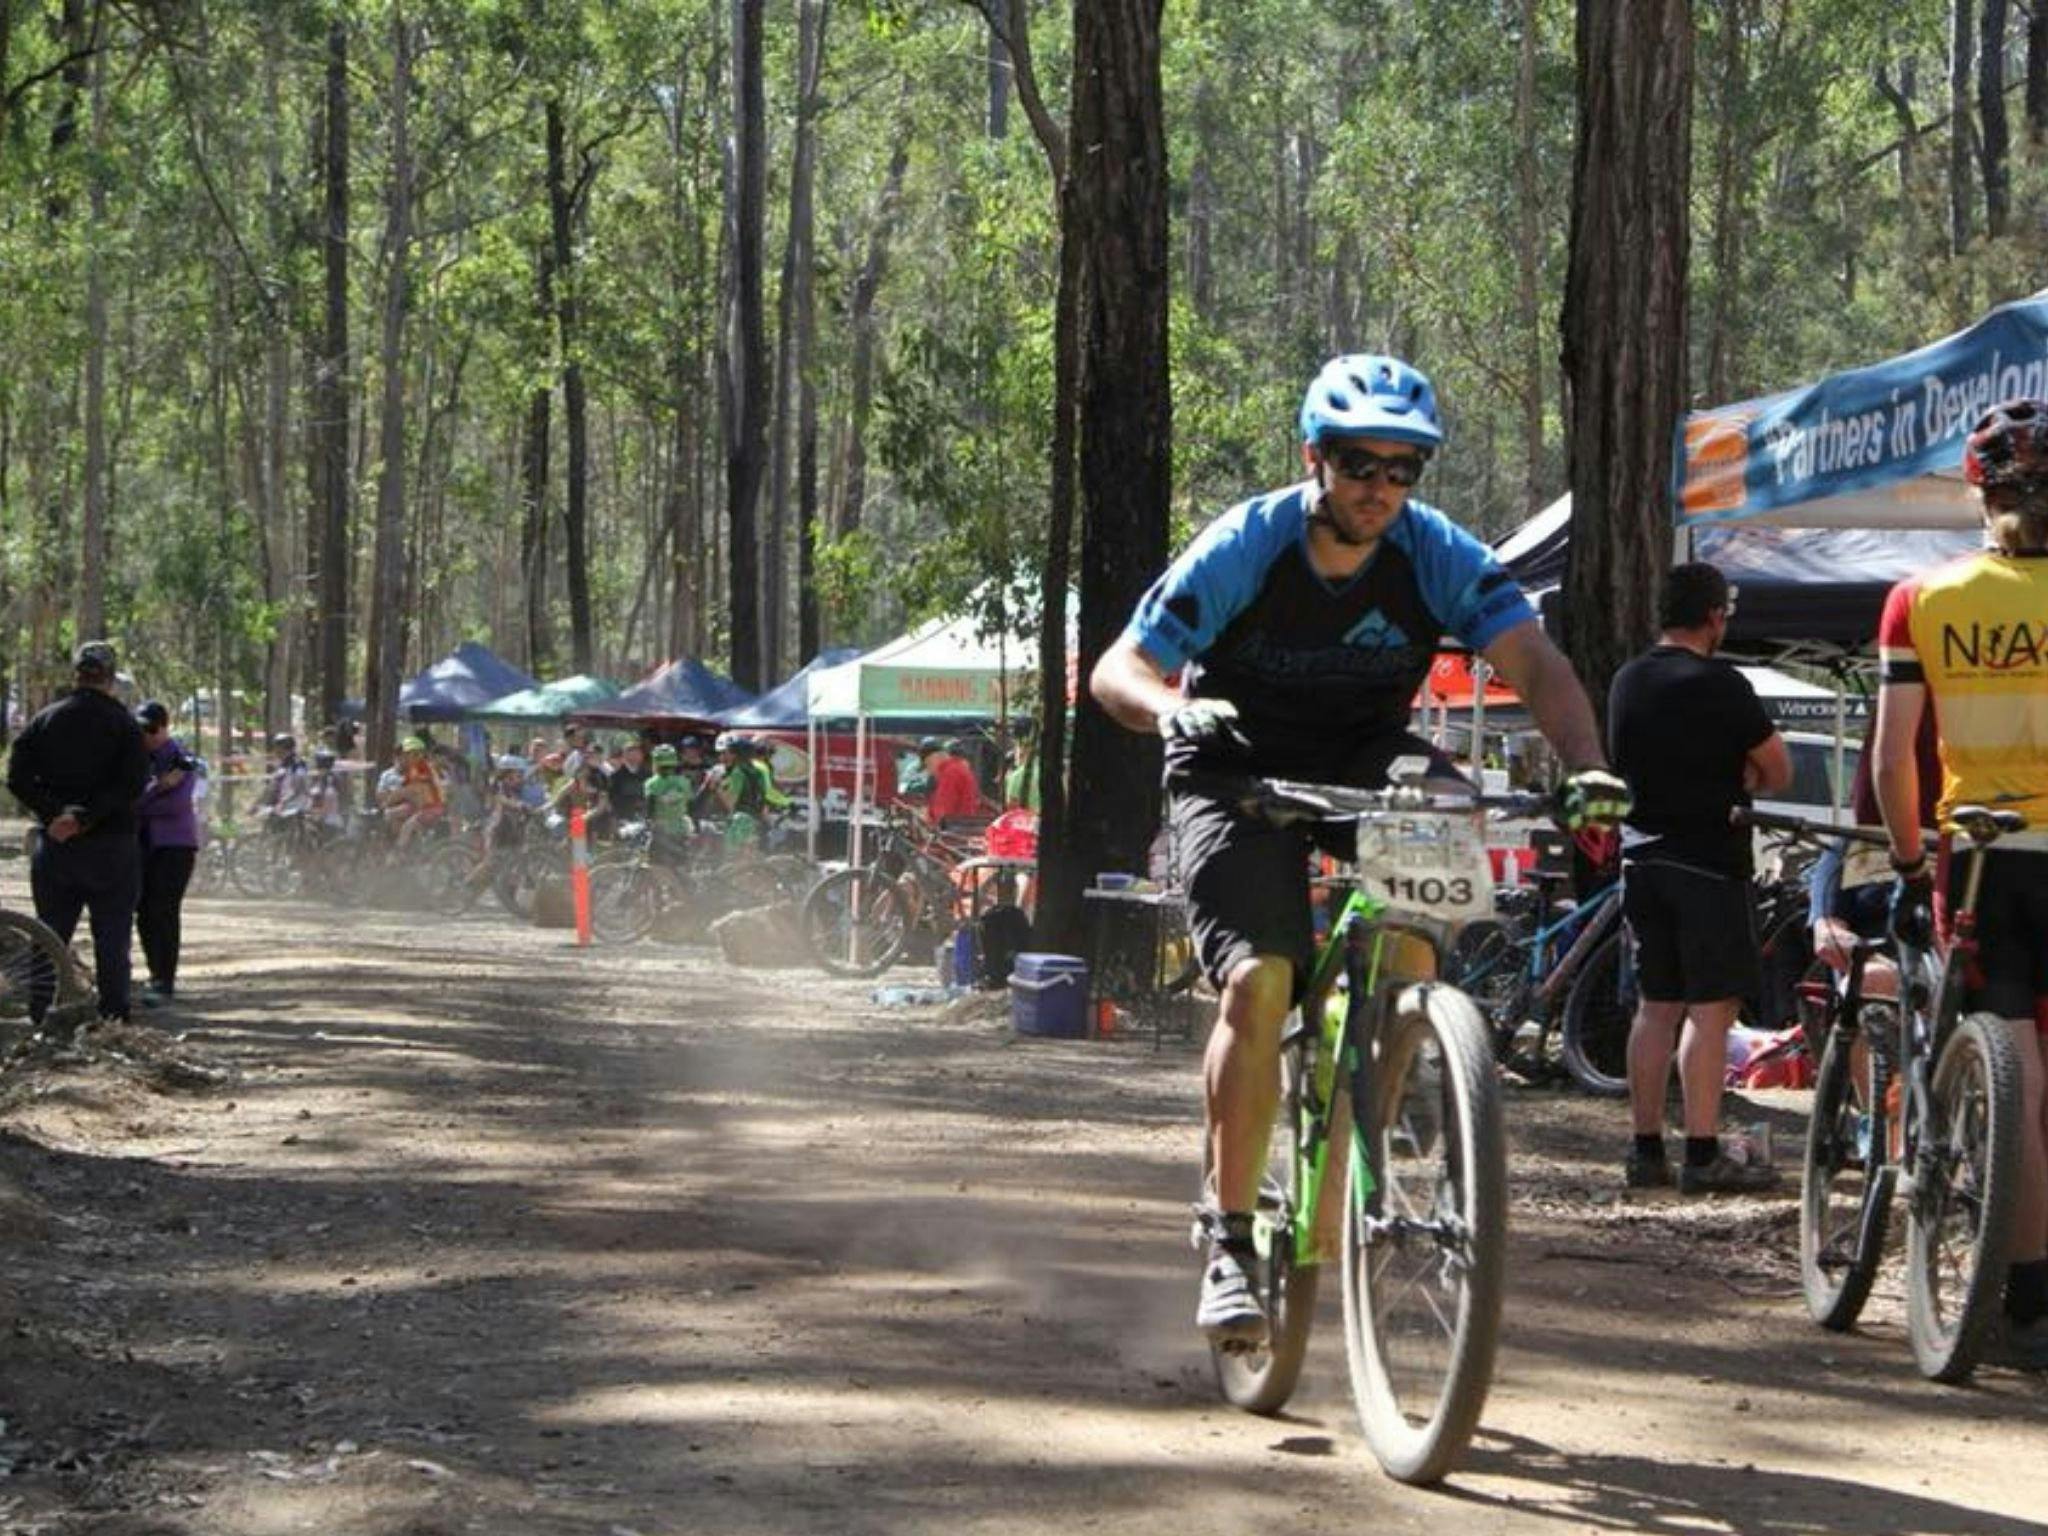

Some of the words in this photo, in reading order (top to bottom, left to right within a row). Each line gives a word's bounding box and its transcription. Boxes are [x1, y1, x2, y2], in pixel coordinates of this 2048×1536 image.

[1768, 408, 1886, 485] Partners
[1889, 387, 1917, 458] in
[1921, 349, 2048, 448] Develop
[1382, 876, 1474, 905] 1103
